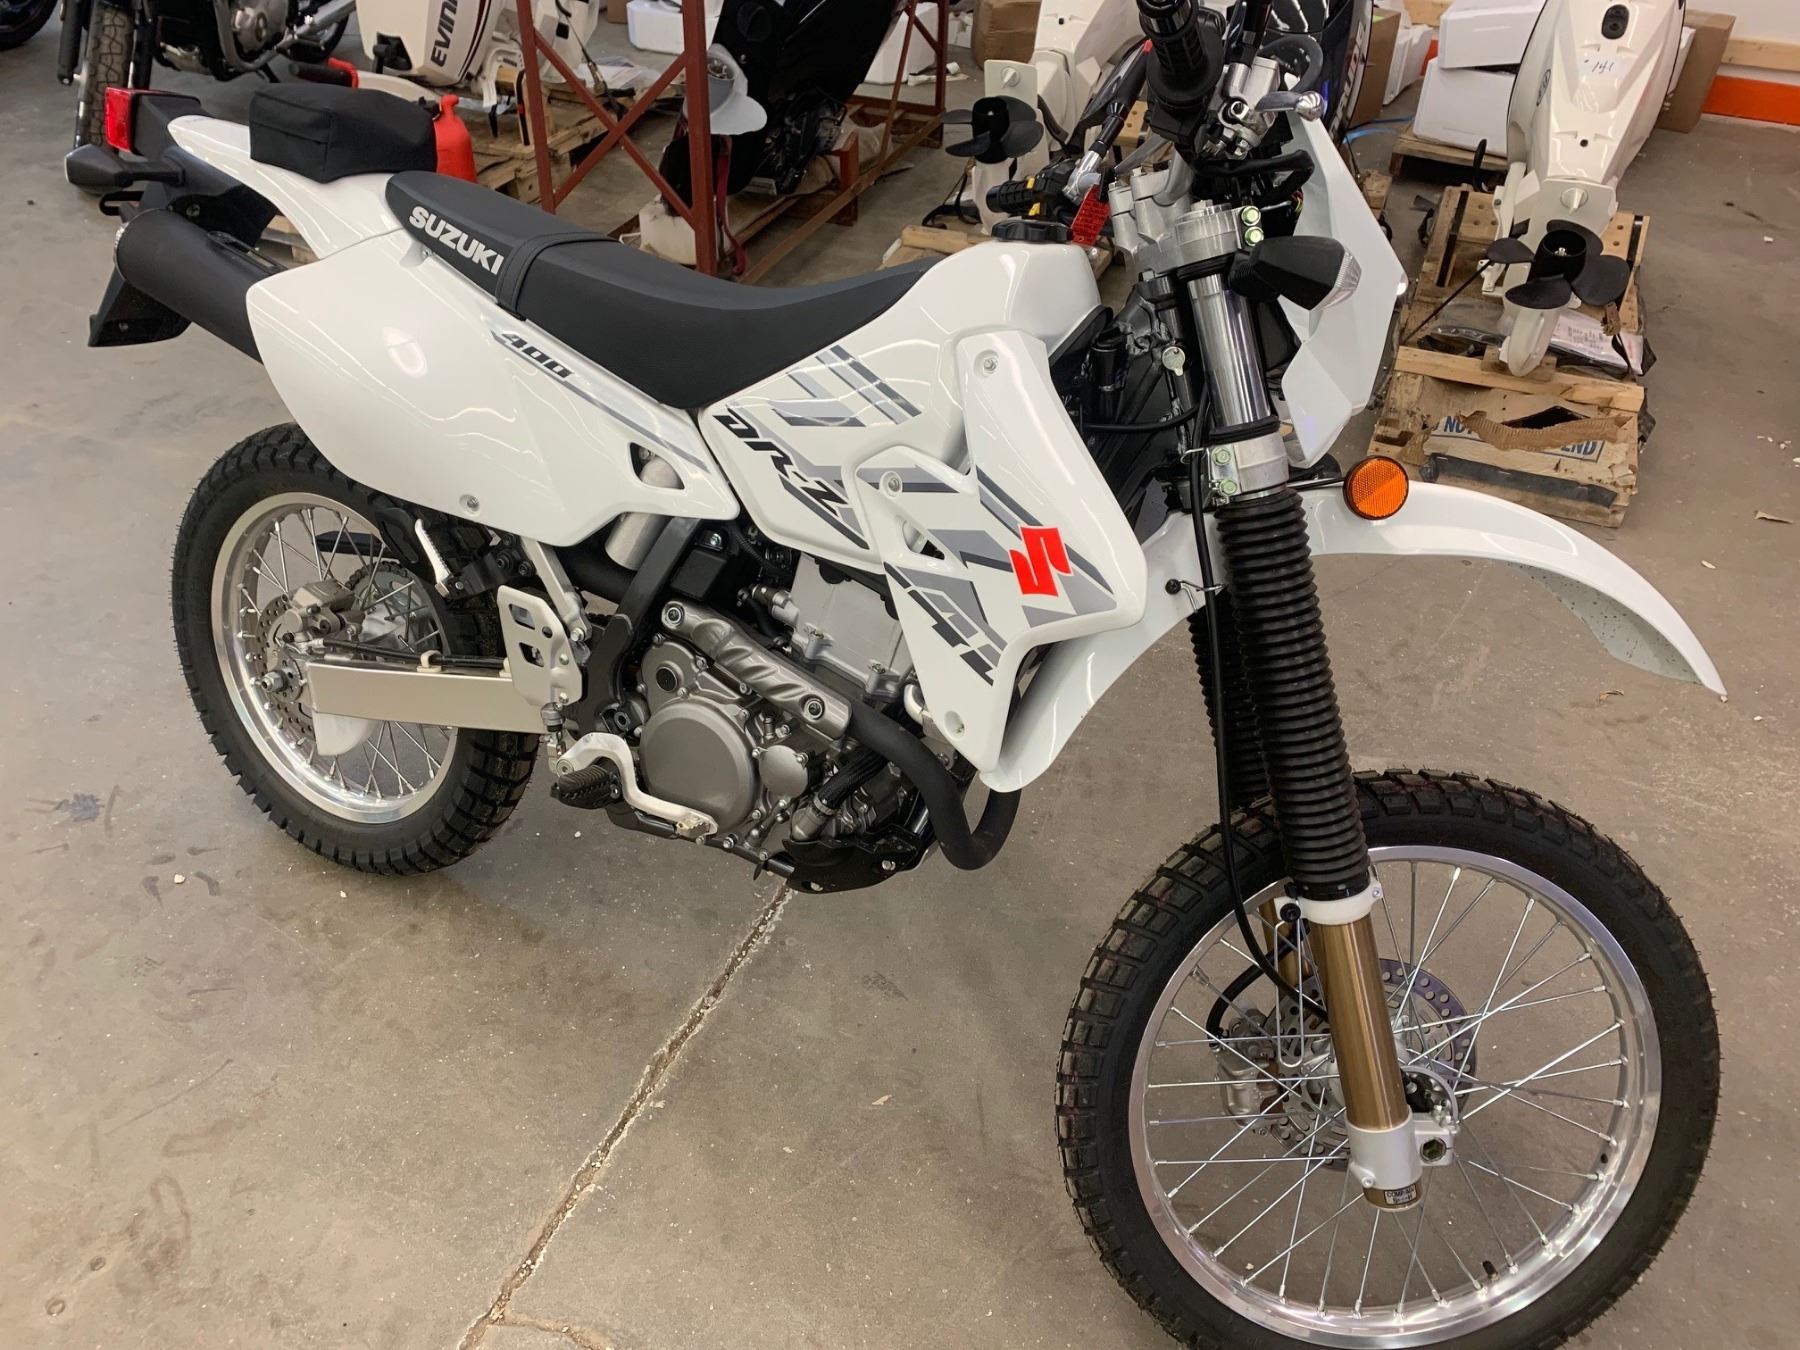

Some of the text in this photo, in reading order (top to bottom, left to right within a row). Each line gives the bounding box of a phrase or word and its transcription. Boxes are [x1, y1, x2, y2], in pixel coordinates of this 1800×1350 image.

[431, 0, 458, 67] EVIN
[409, 206, 504, 275] SUZUKI
[501, 333, 574, 379] 400
[1443, 415, 1472, 434] NO
